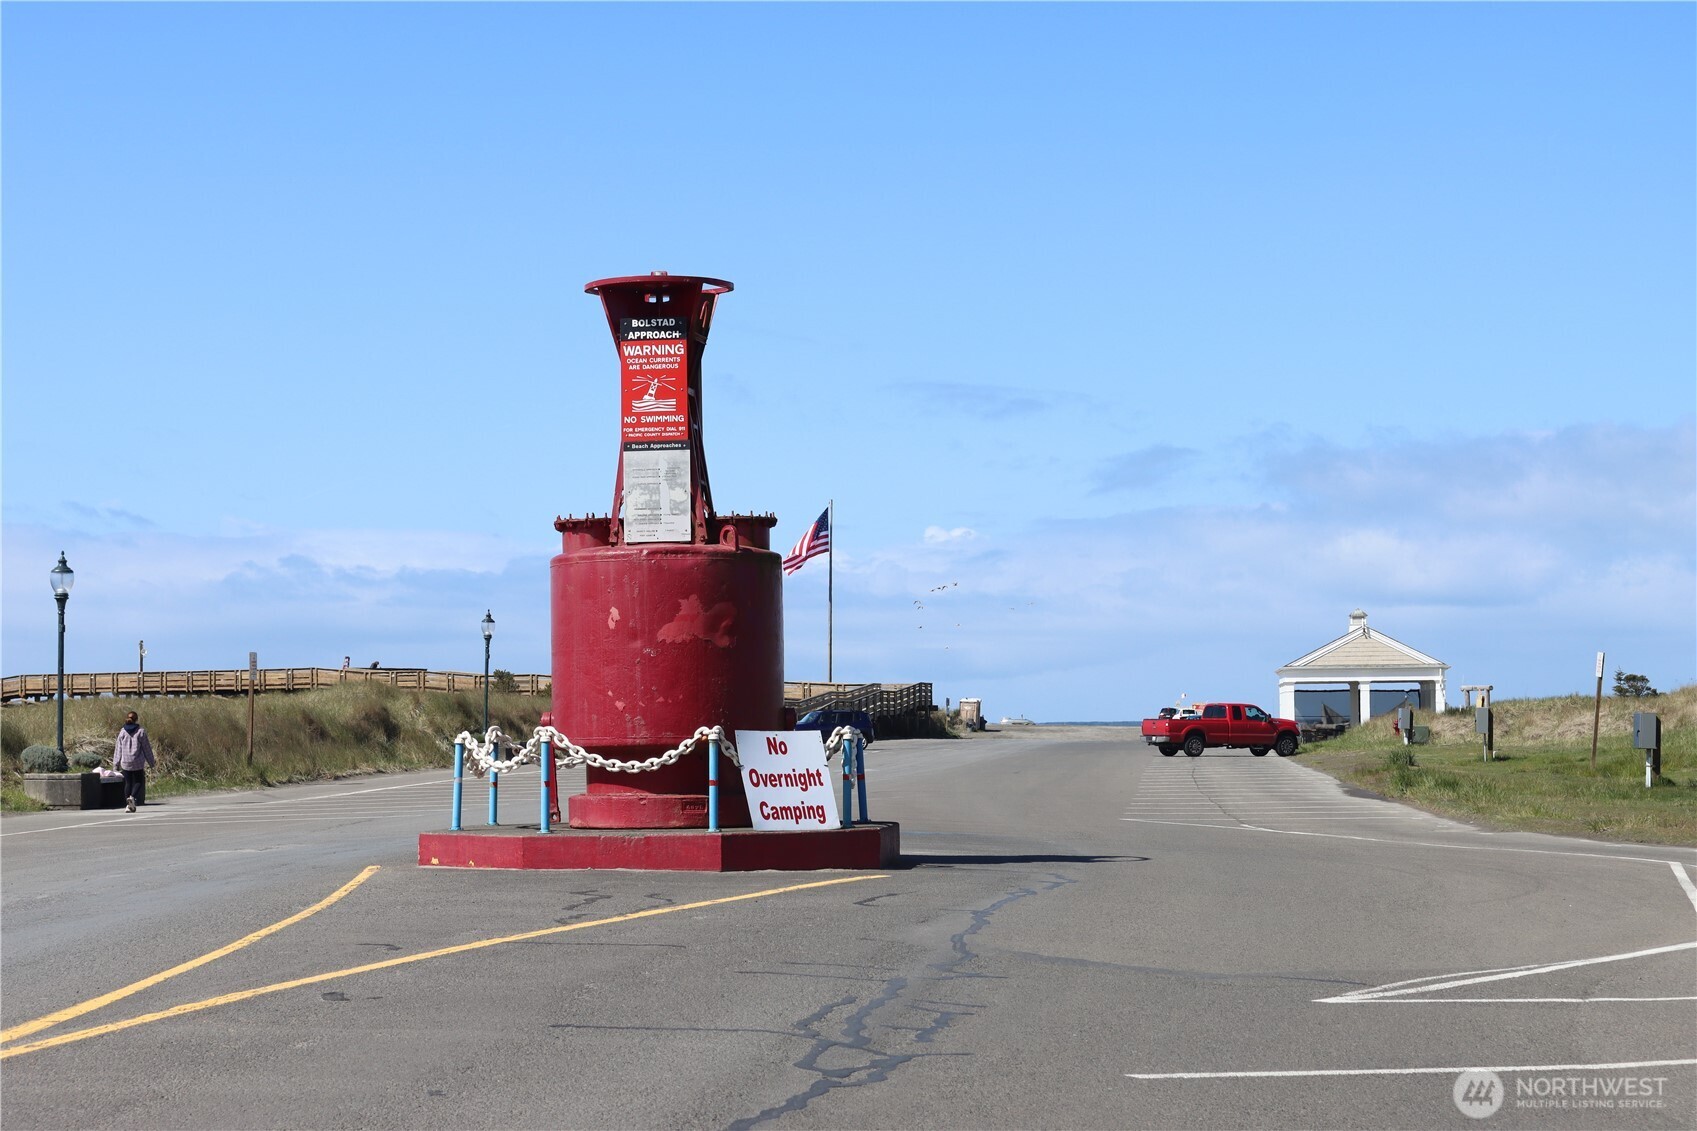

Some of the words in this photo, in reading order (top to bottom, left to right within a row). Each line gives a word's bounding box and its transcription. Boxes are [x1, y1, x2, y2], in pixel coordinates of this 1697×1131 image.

[632, 319, 675, 328] BOLSTAD
[628, 331, 679, 340] APPROACH
[623, 344, 684, 356] WARNING
[640, 414, 684, 423] SWIMMING
[766, 736, 788, 755] No
[748, 768, 824, 792] Overnight
[760, 801, 826, 824] Camping
